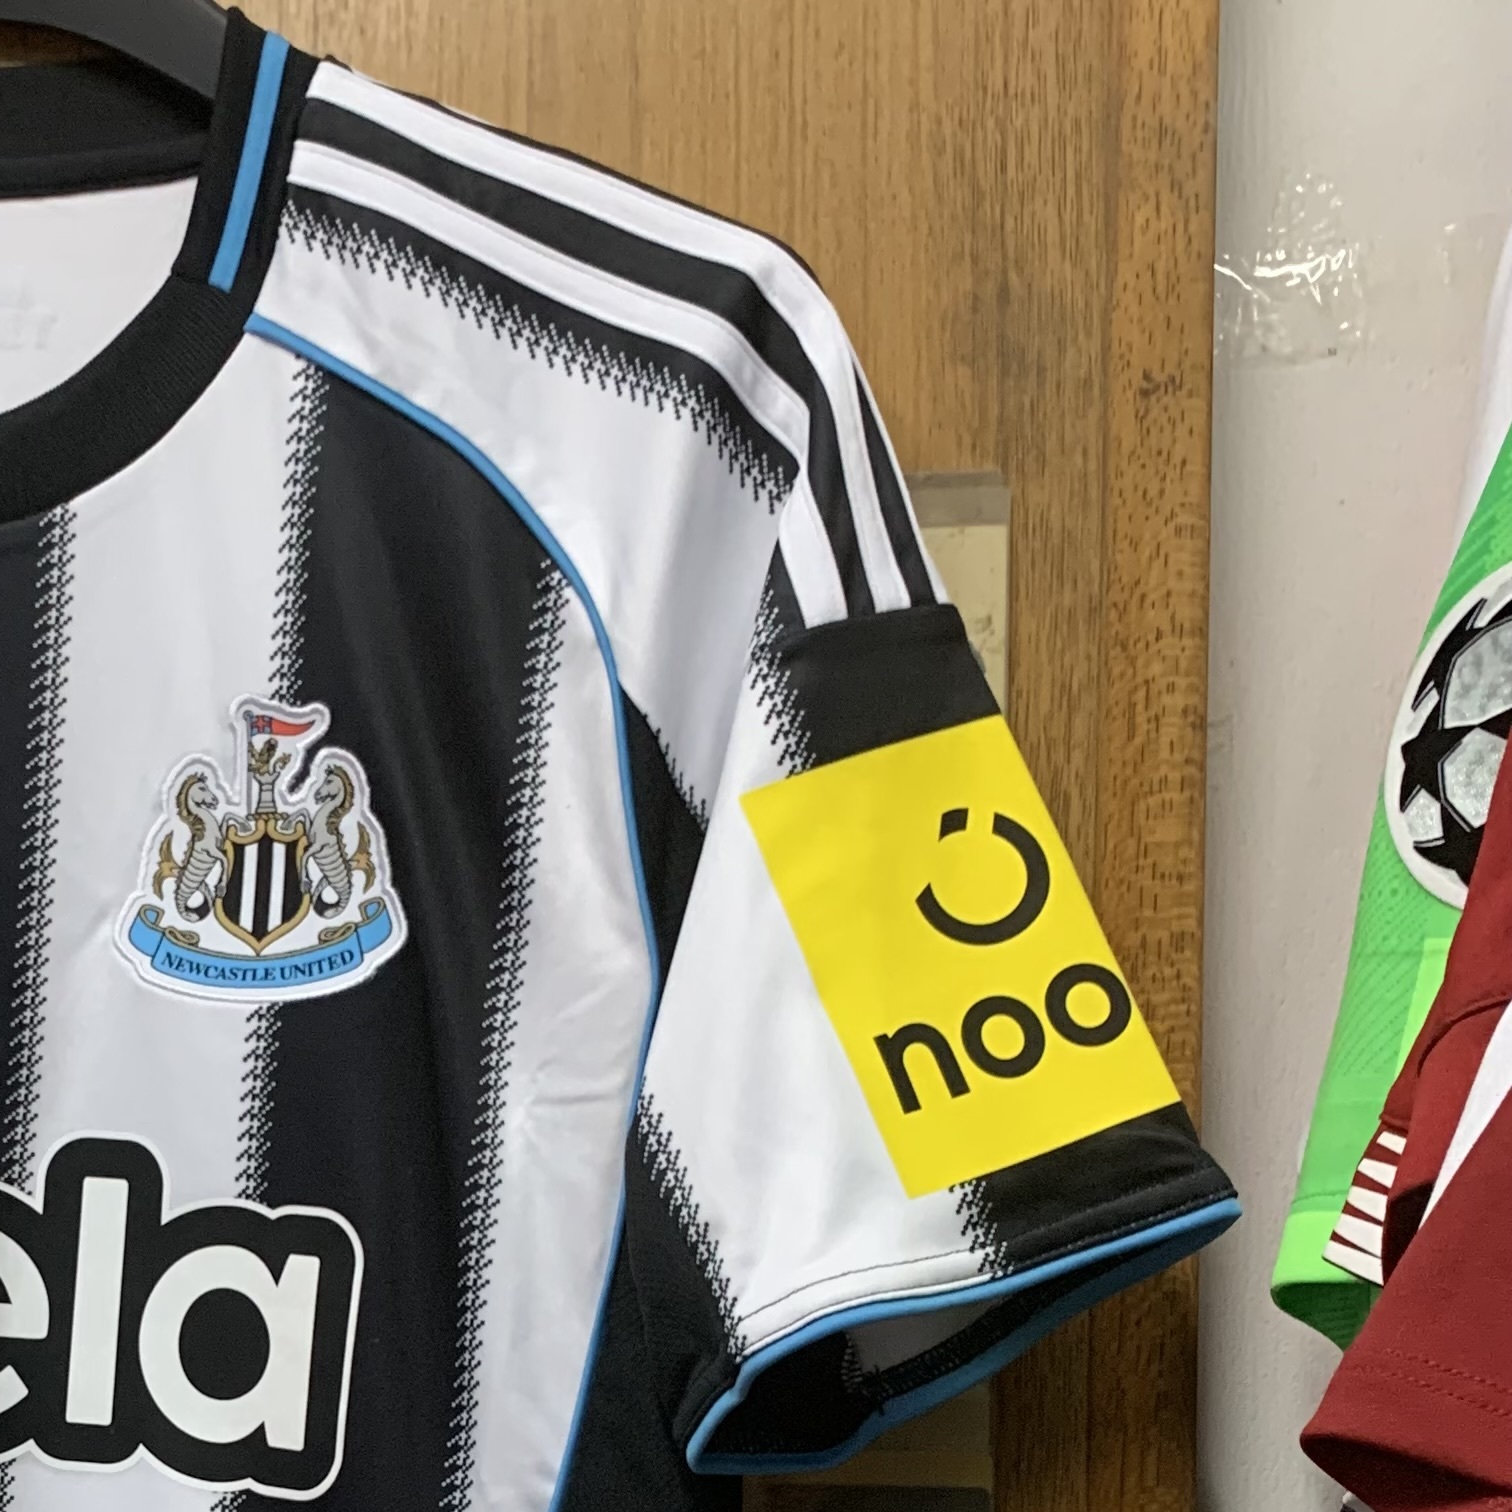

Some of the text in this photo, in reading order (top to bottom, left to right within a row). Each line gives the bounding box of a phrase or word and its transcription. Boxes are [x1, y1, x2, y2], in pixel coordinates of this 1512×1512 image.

[161, 949, 355, 982] NEWCASTLE UNITED
[873, 962, 1132, 1115] noo
